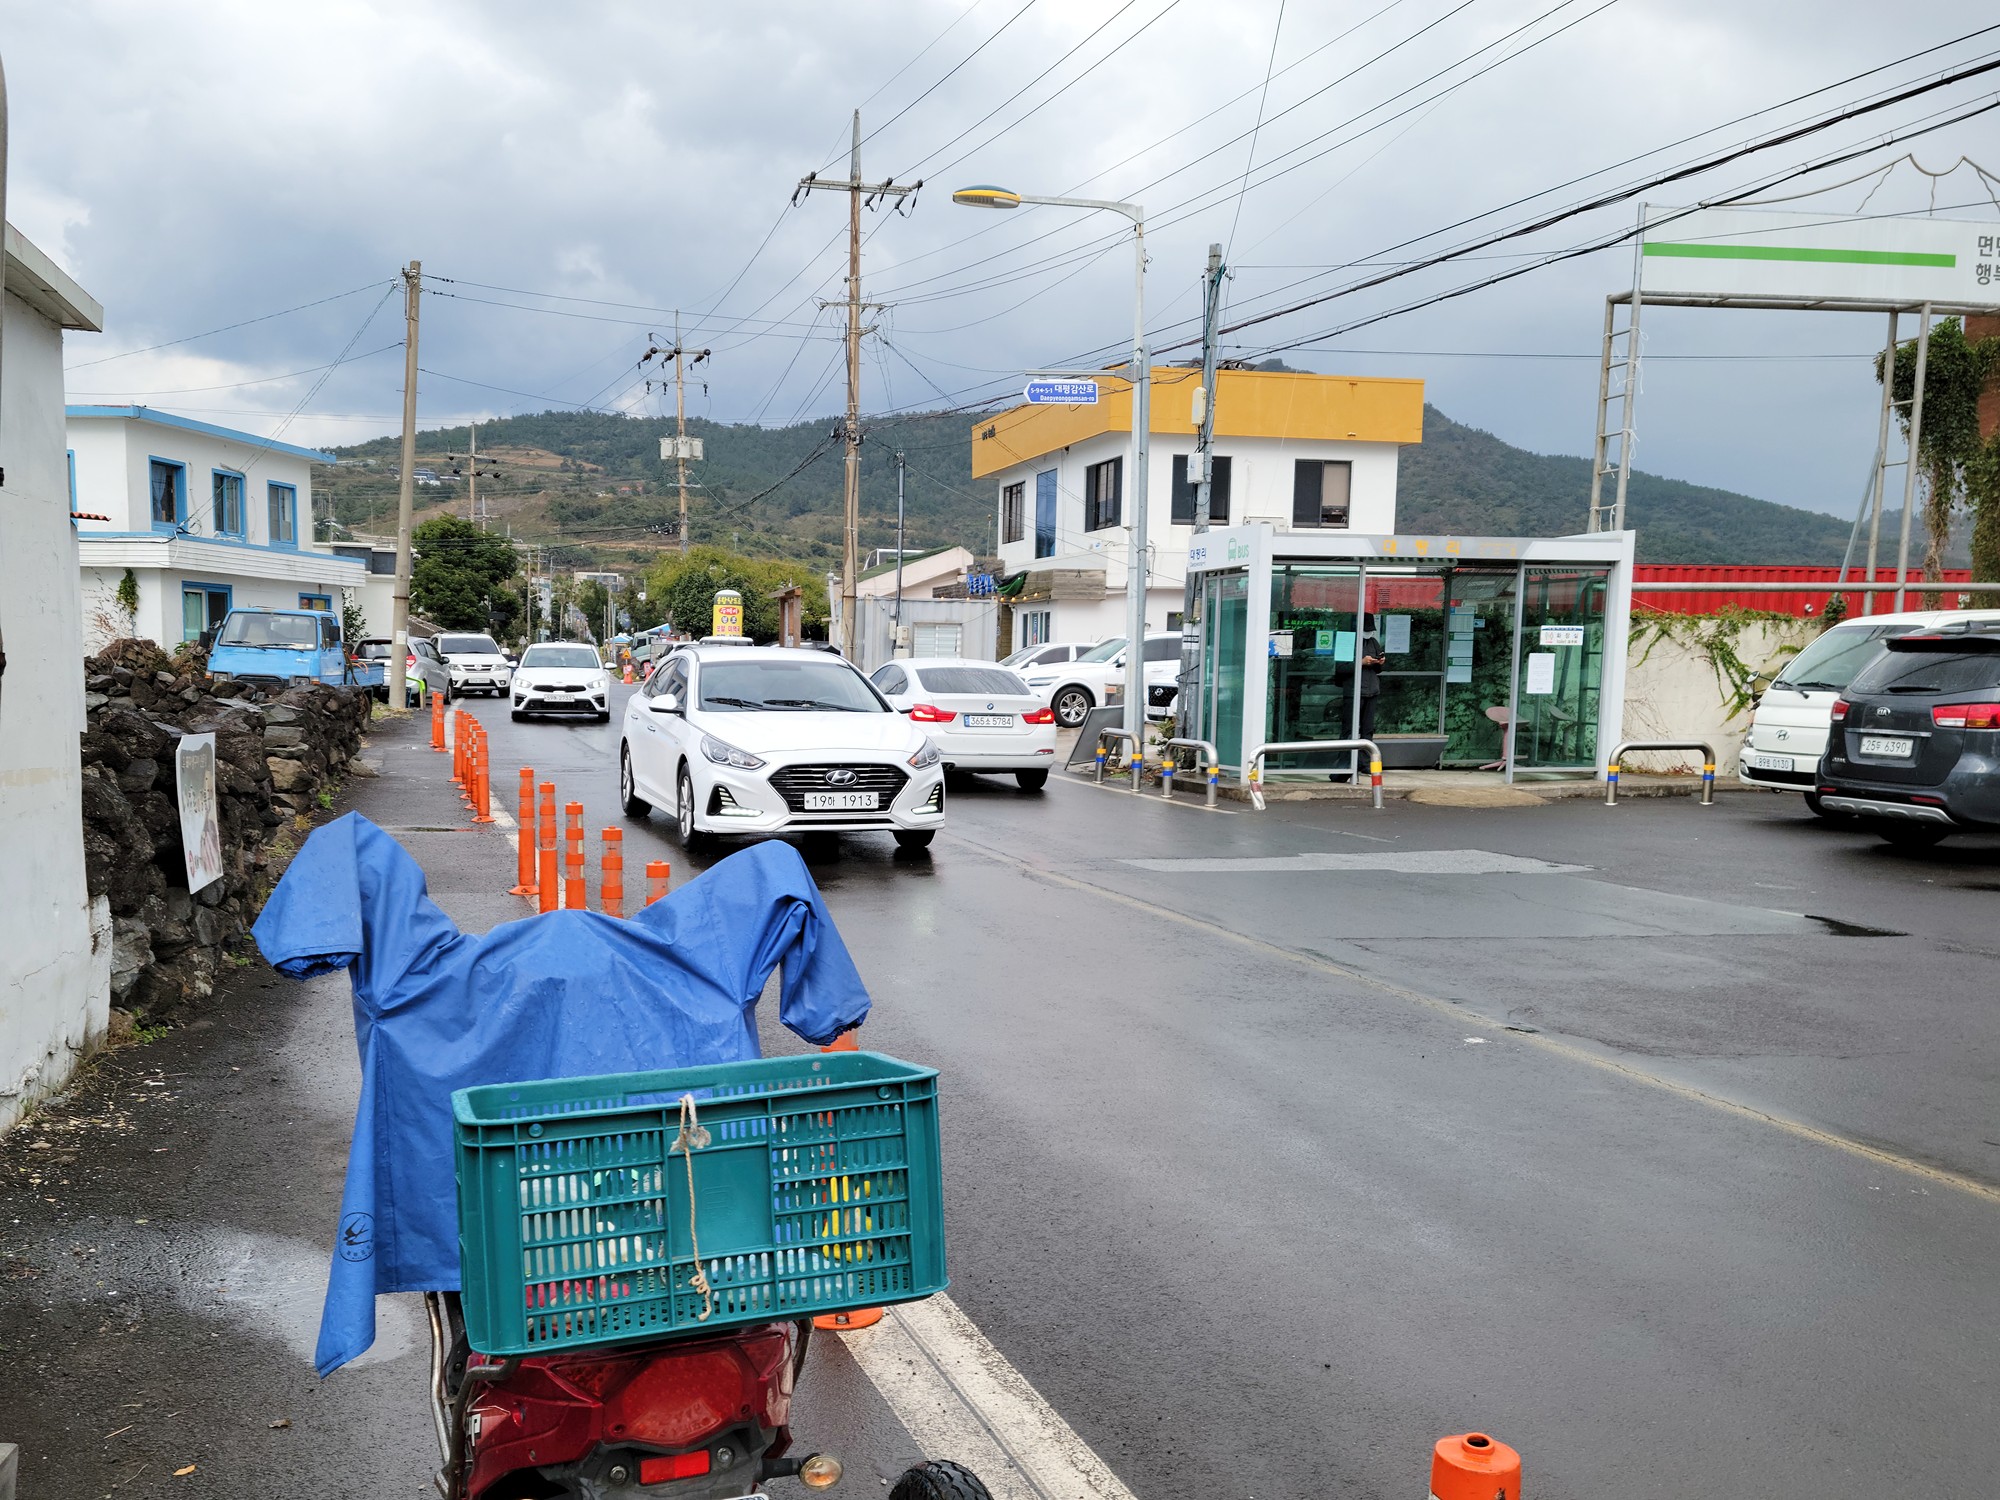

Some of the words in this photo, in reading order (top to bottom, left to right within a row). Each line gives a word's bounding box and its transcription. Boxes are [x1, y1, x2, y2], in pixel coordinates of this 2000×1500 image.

[1054, 384, 1095, 395] 대평감산로
[1238, 545, 1250, 559] BUS
[1383, 540, 1460, 556] 대평리
[992, 717, 1011, 726] 5784
[1884, 741, 1907, 753] 6390
[1773, 758, 1789, 769] 0130
[812, 795, 835, 807] 19하
[842, 794, 872, 807] 1913
